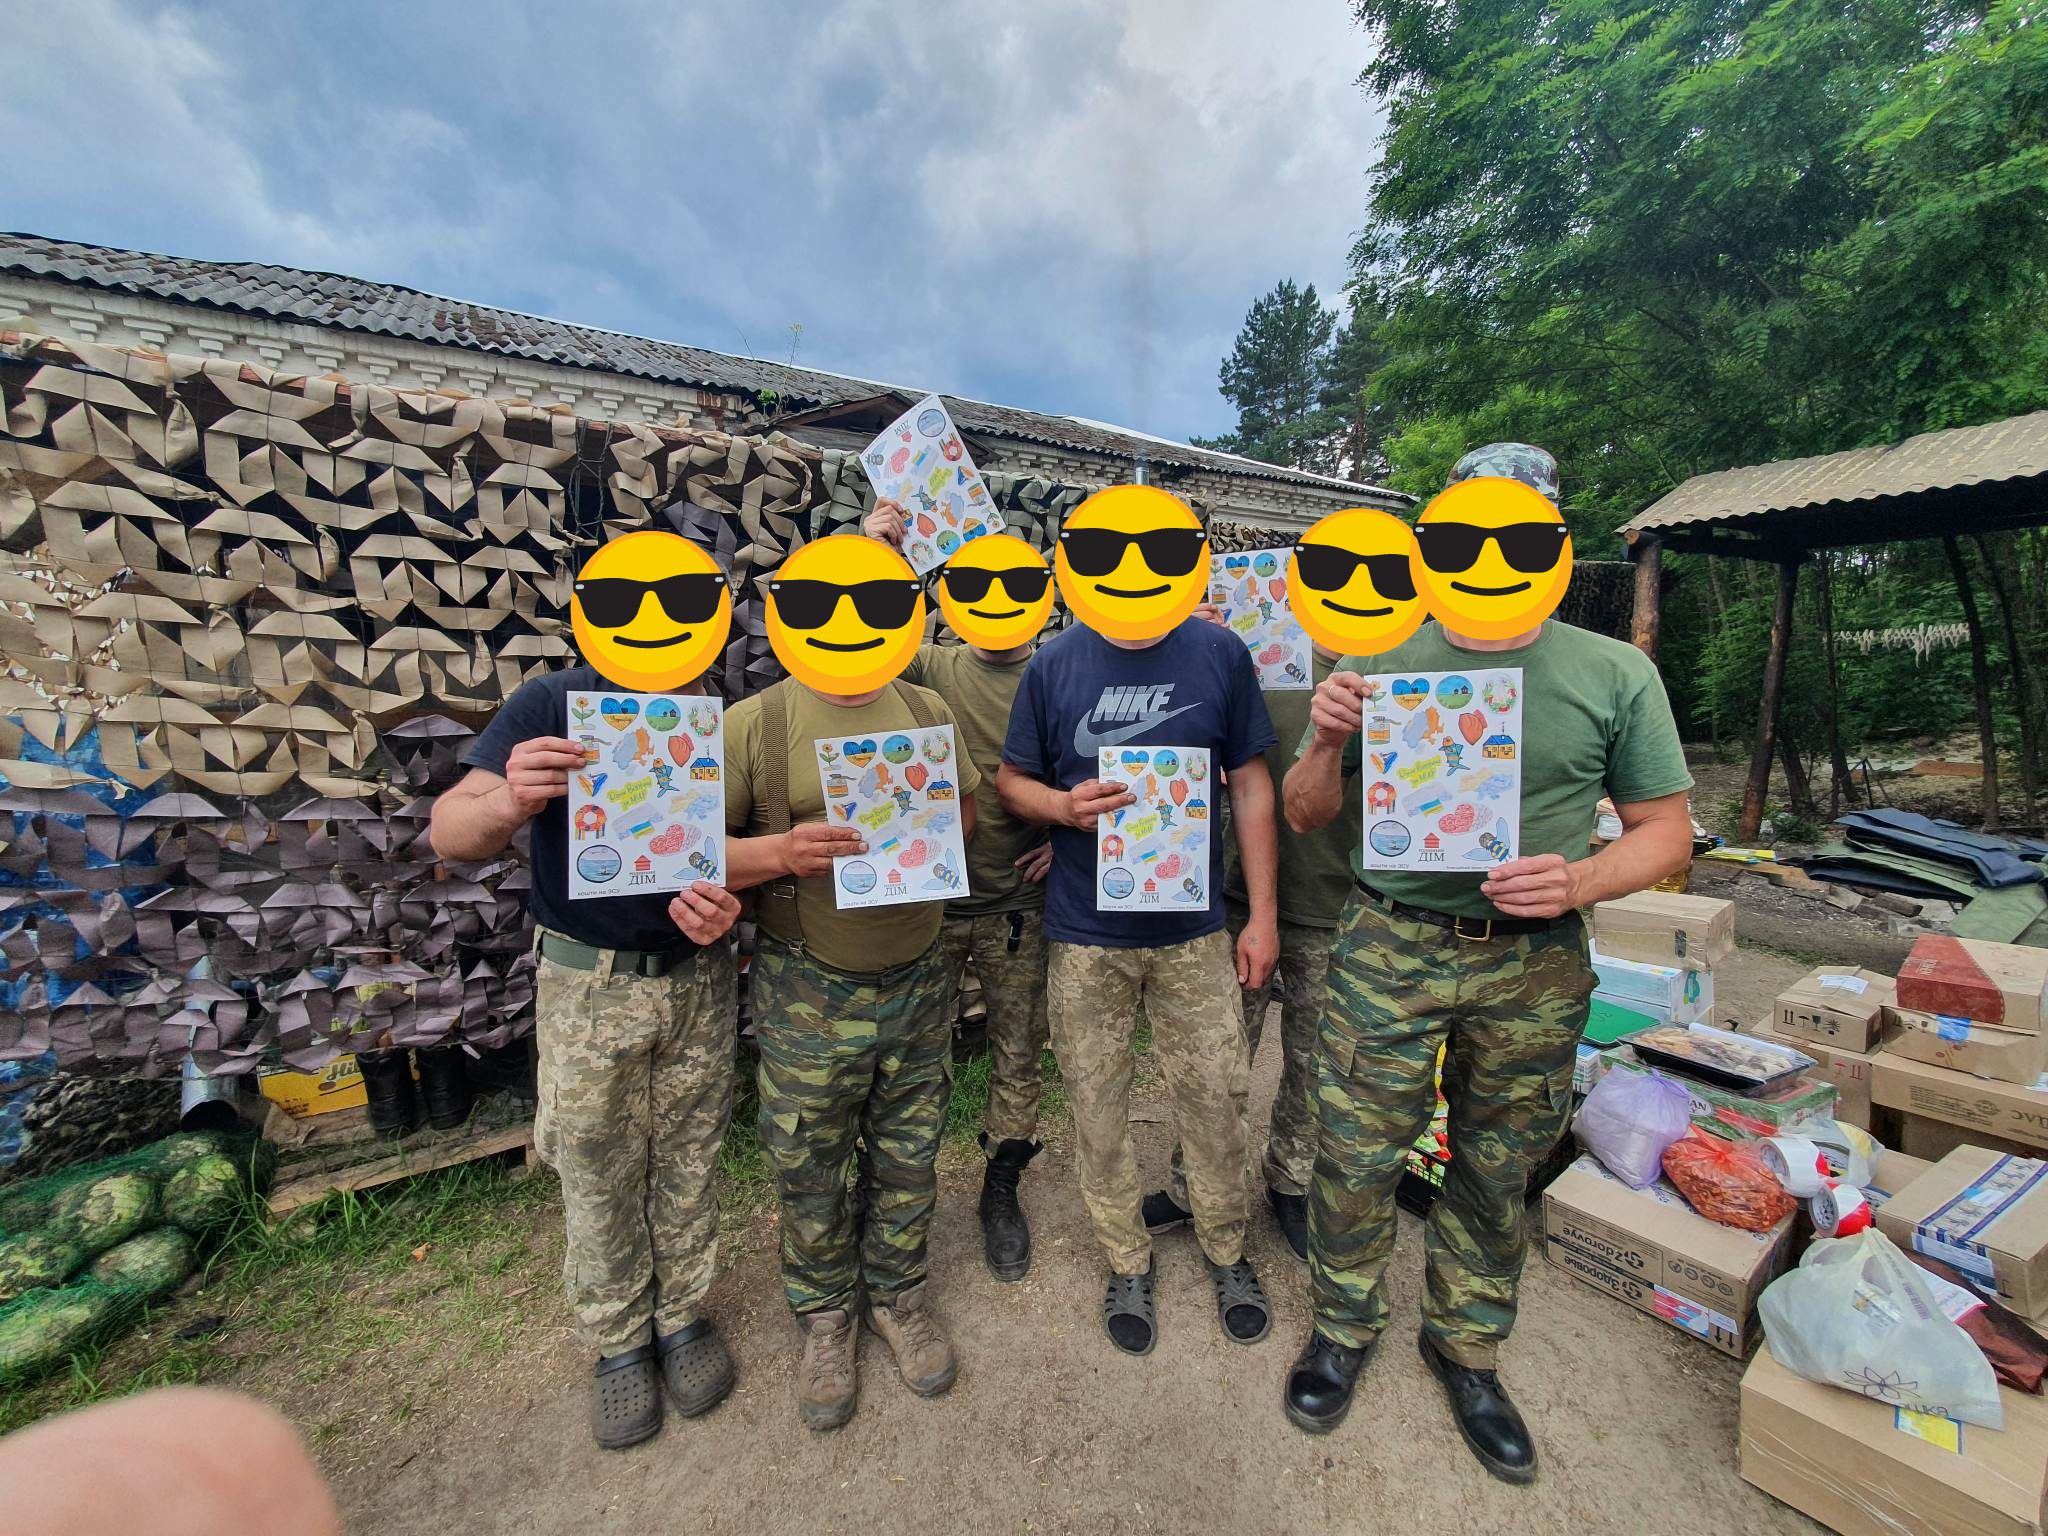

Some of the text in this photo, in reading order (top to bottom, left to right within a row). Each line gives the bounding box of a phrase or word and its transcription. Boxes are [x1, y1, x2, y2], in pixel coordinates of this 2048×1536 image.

[1091, 683, 1175, 723] NIKE
[1418, 853, 1446, 862] ДІМ
[629, 875, 657, 886] ДІМ
[885, 886, 907, 896] ДІМ
[1140, 895, 1160, 904] ДІМ
[1562, 1227, 1625, 1263] Zdorovye
[1564, 1255, 1620, 1291] Здоровье
